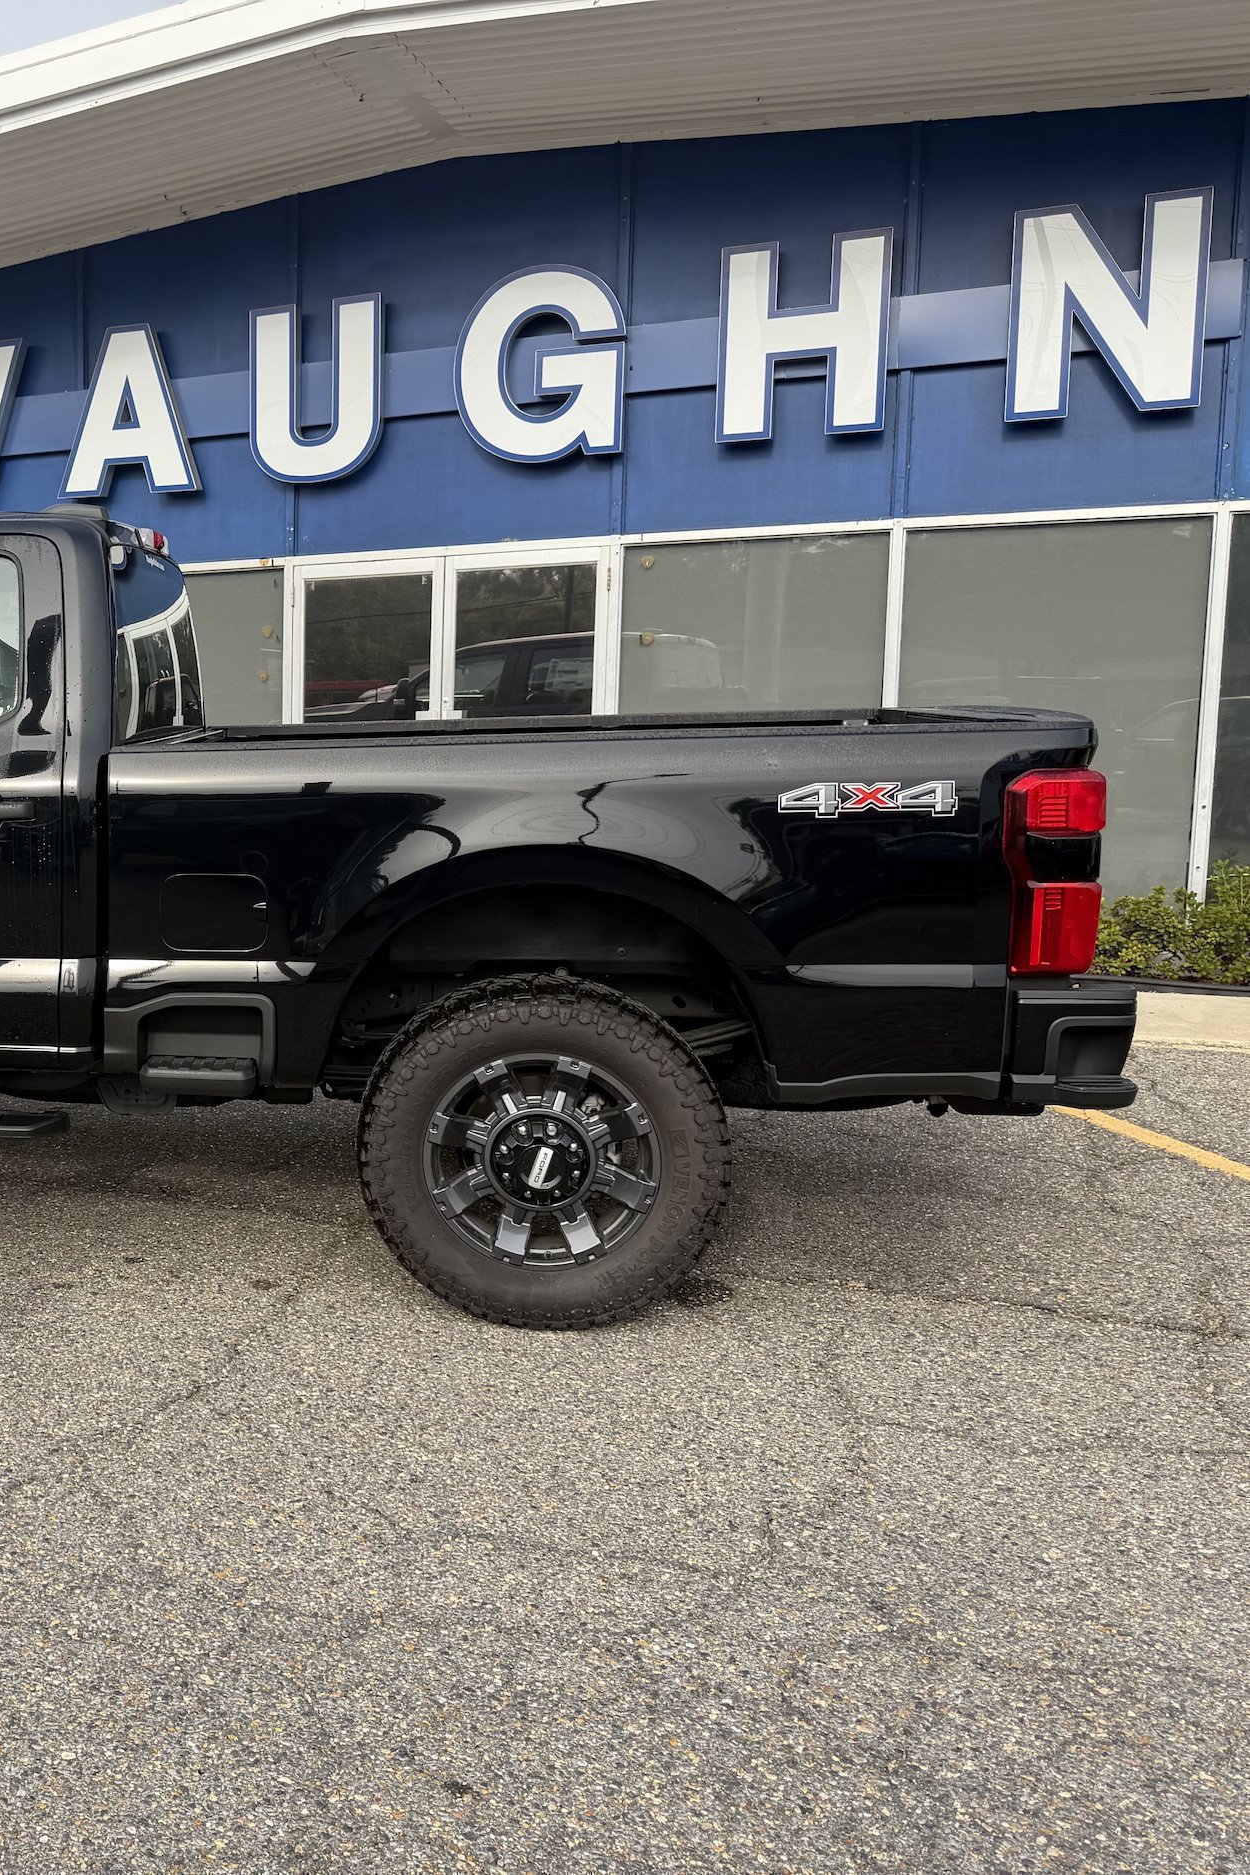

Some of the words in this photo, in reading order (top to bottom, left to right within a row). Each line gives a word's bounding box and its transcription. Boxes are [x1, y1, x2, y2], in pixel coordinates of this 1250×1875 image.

[533, 1152, 549, 1184] FORD
[657, 1161, 691, 1236] VENOM
[594, 1237, 666, 1290] POWER
